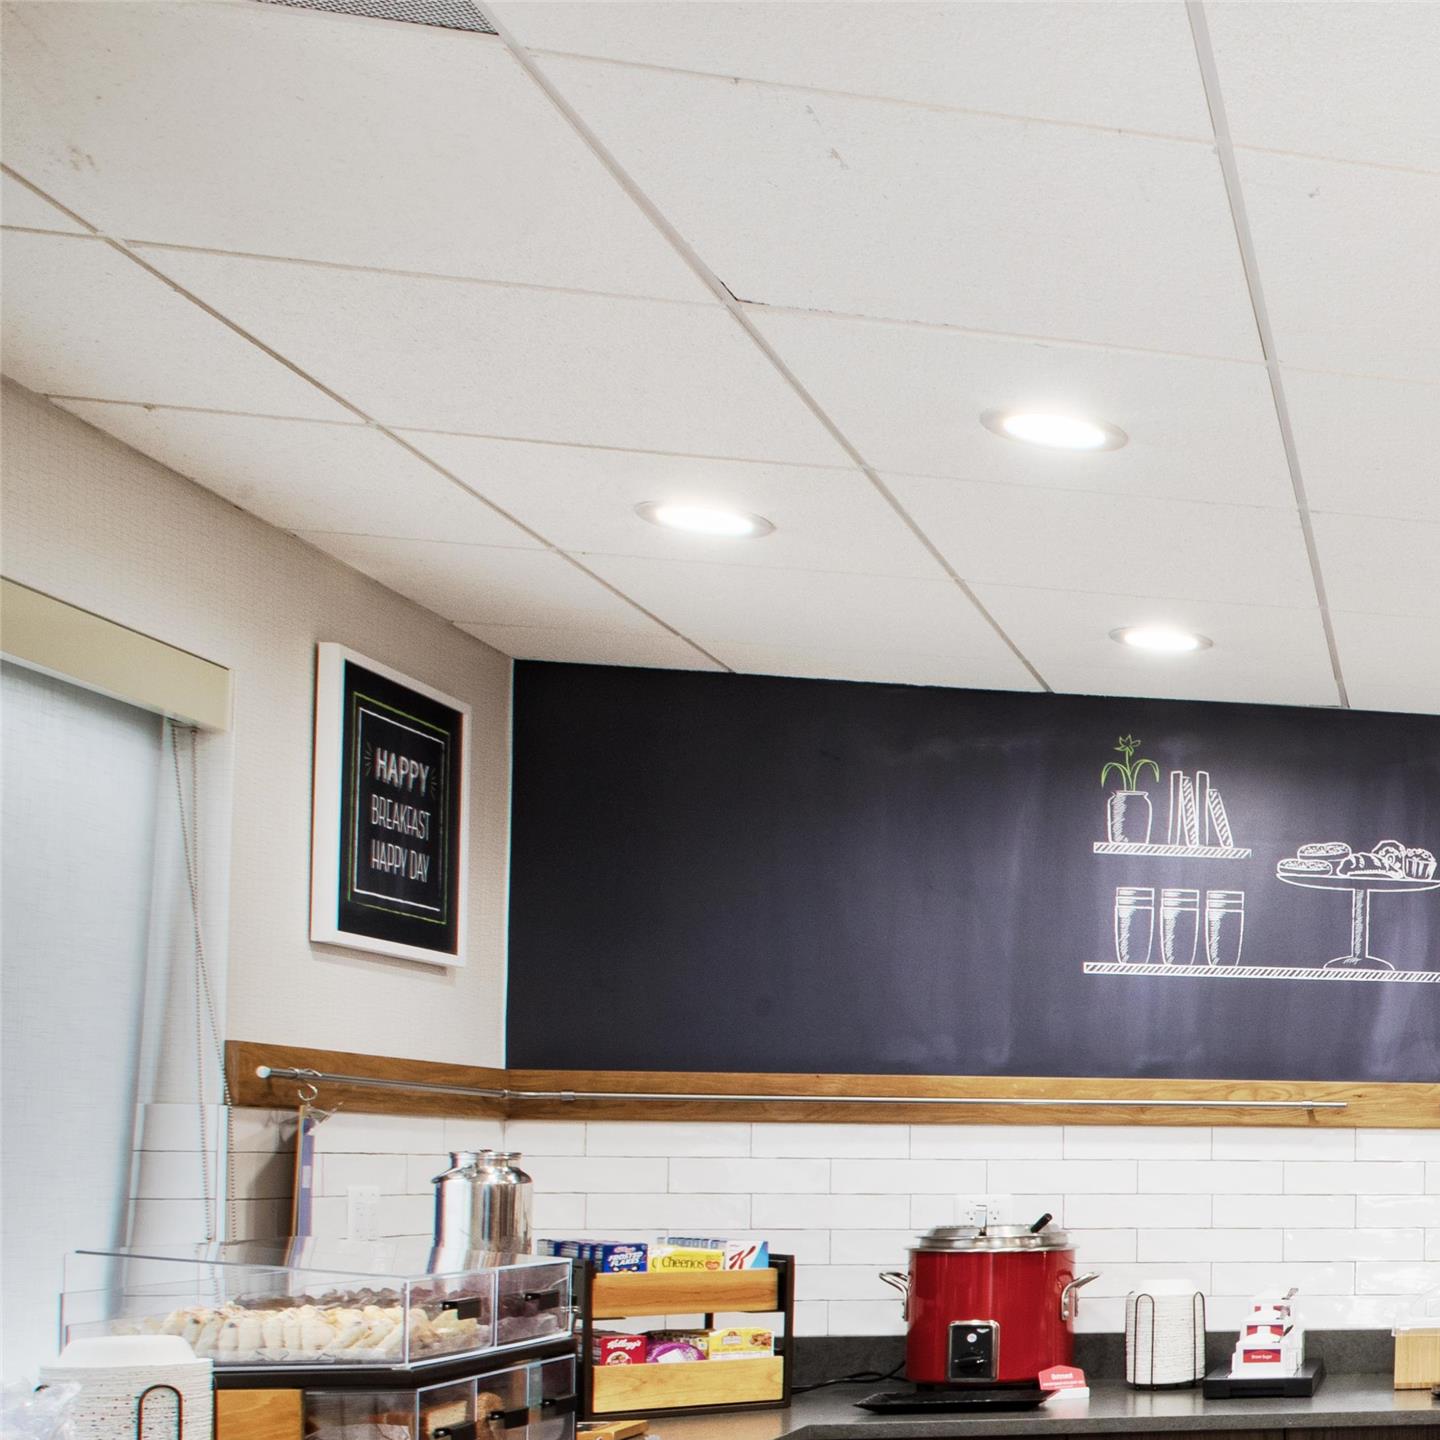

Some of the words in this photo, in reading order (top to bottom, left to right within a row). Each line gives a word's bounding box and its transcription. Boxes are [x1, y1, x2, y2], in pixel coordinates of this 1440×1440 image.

[376, 748, 430, 797] HAPPY
[371, 794, 431, 840] BREAKFAST
[371, 839, 409, 877] HAPPY
[409, 850, 430, 883] DAY
[662, 1256, 704, 1268] Cheerios
[607, 1338, 642, 1351] Kellogg's
